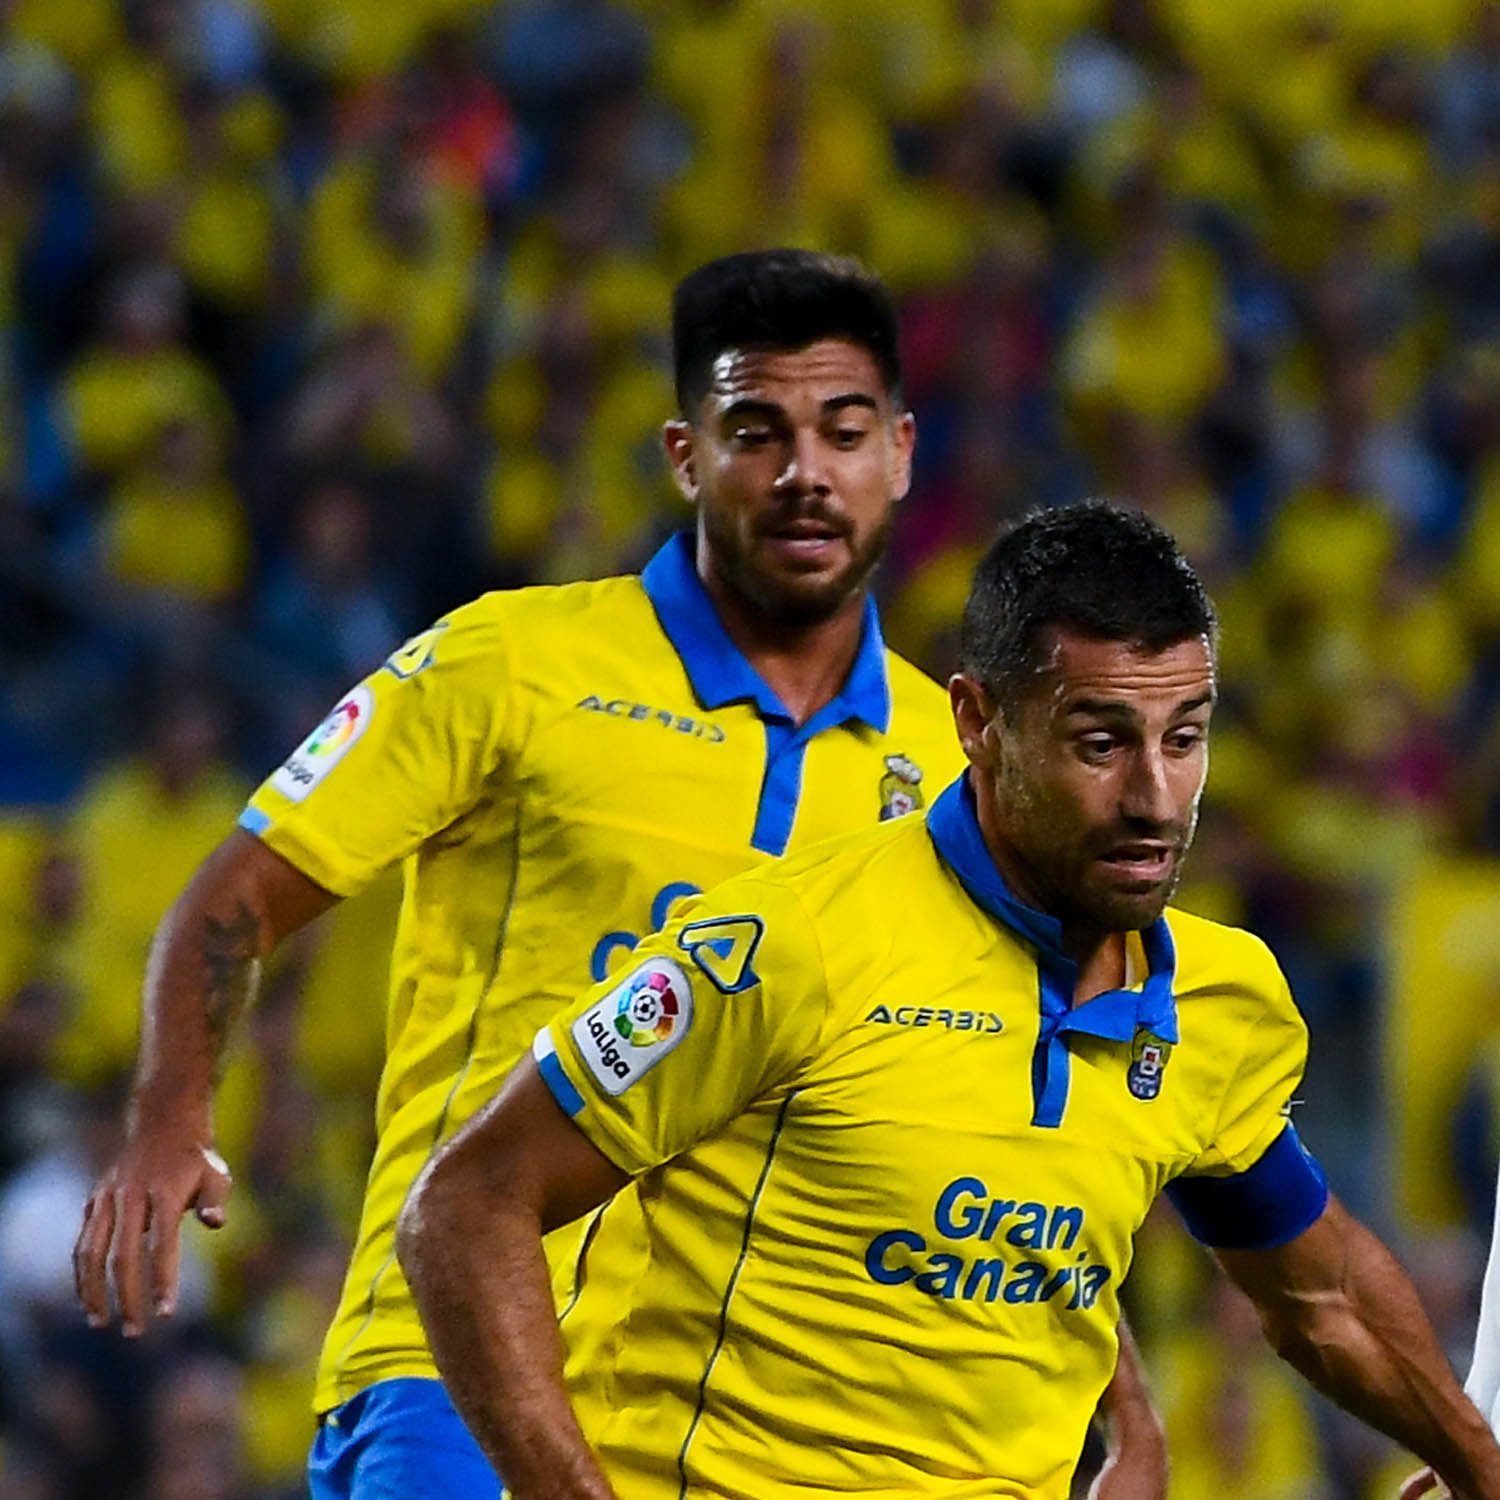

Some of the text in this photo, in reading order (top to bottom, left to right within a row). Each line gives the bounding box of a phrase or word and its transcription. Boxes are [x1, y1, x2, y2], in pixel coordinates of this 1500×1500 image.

[586, 1011, 631, 1079] LaLiga
[934, 1176, 1085, 1250] Gran
[865, 1230, 1111, 1311] Canaria
